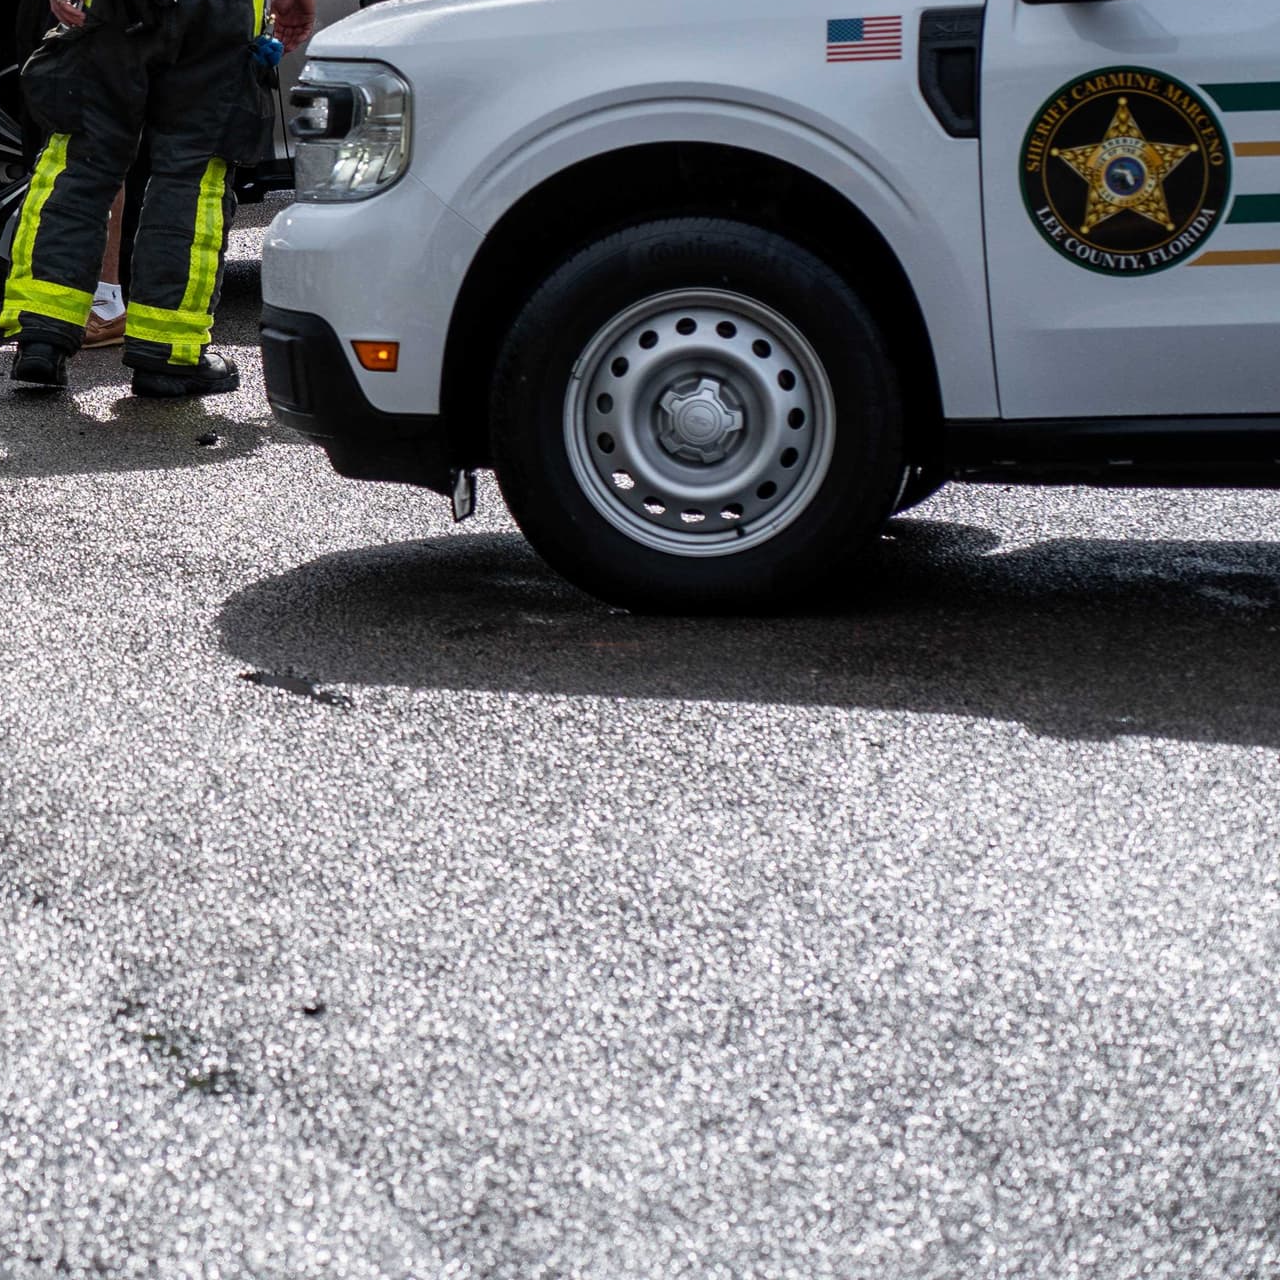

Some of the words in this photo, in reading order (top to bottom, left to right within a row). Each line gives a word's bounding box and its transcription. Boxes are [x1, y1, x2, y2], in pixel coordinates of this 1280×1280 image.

[1027, 93, 1070, 172] SHERIFF
[1071, 73, 1160, 100] CARMINE
[1162, 82, 1225, 166] MARCENO
[1036, 206, 1065, 240] LEE
[1064, 236, 1145, 269] COUNTY,
[1147, 207, 1217, 266] FLORIDA
